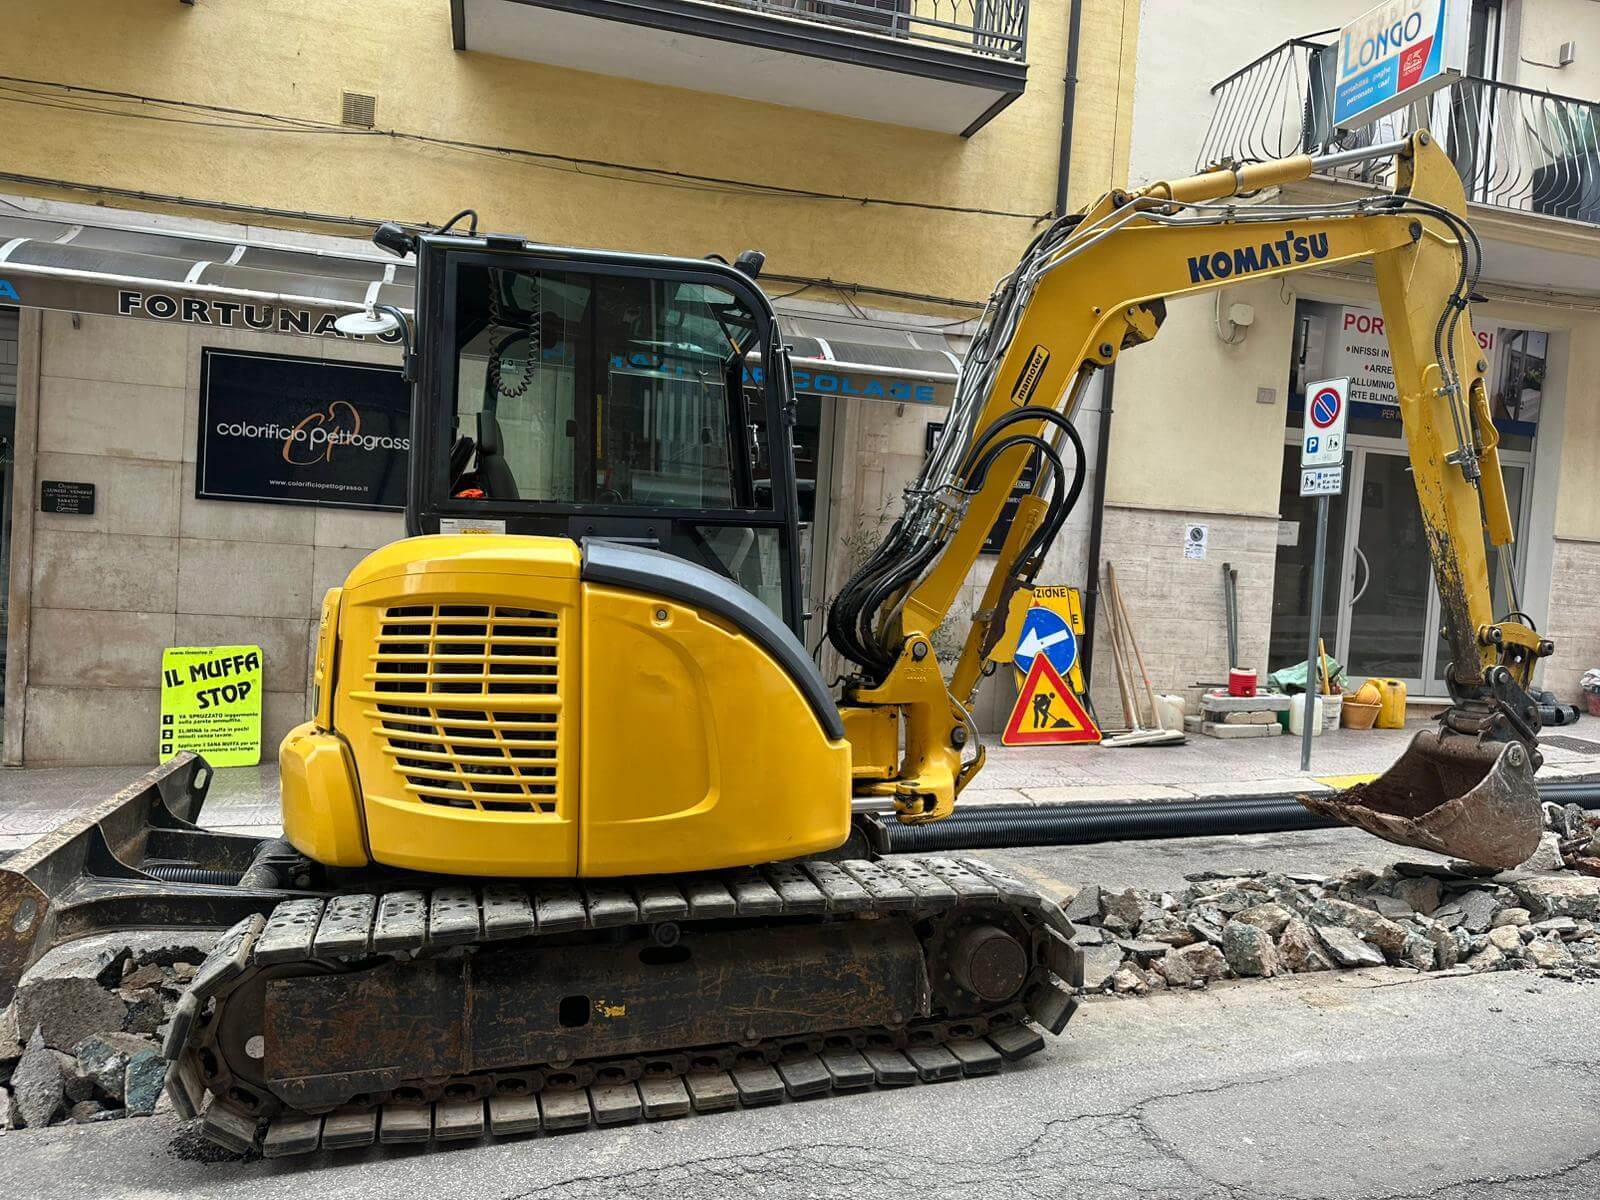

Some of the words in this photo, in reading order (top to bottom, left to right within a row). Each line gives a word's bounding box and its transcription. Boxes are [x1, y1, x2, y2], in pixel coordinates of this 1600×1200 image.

[1343, 11, 1421, 78] LONGO
[1187, 231, 1329, 283] KOMATSU
[119, 290, 404, 344] FORTUNA
[1344, 313, 1385, 335] POR
[1351, 345, 1379, 357] INFISSI
[1018, 353, 1044, 400] mamoter
[1370, 365, 1395, 375] ARRE
[1351, 391, 1367, 400] RTE
[217, 421, 307, 442] colorificio
[269, 478, 369, 492] www.colorificiopettograsso.it
[164, 669, 185, 688] IL
[189, 652, 259, 682] MUFFA
[196, 681, 252, 709] STOP
